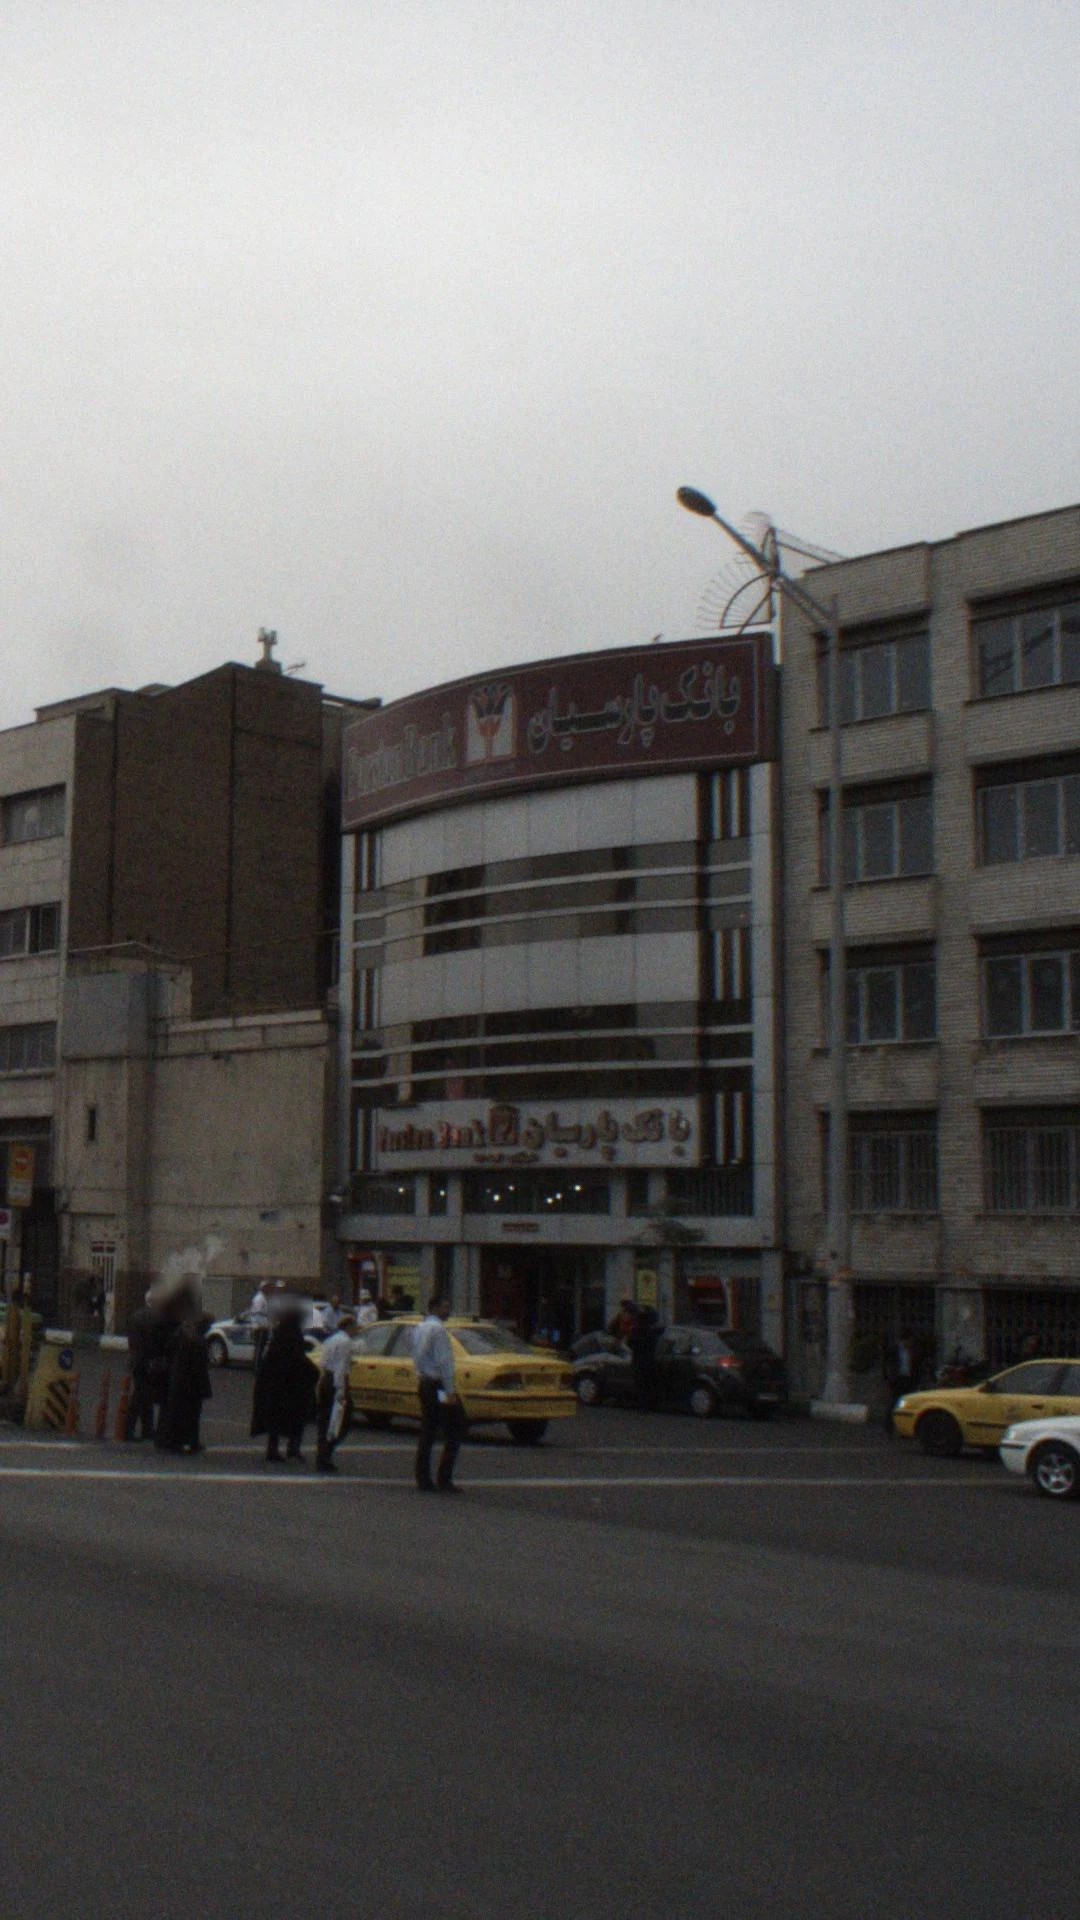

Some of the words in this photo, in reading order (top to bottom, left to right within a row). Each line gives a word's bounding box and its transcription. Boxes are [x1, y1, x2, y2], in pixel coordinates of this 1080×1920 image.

[526, 671, 658, 754] پارسیان
[660, 659, 741, 736] بانک
[522, 1110, 619, 1161] پارسیان
[621, 1107, 690, 1157] بانک
